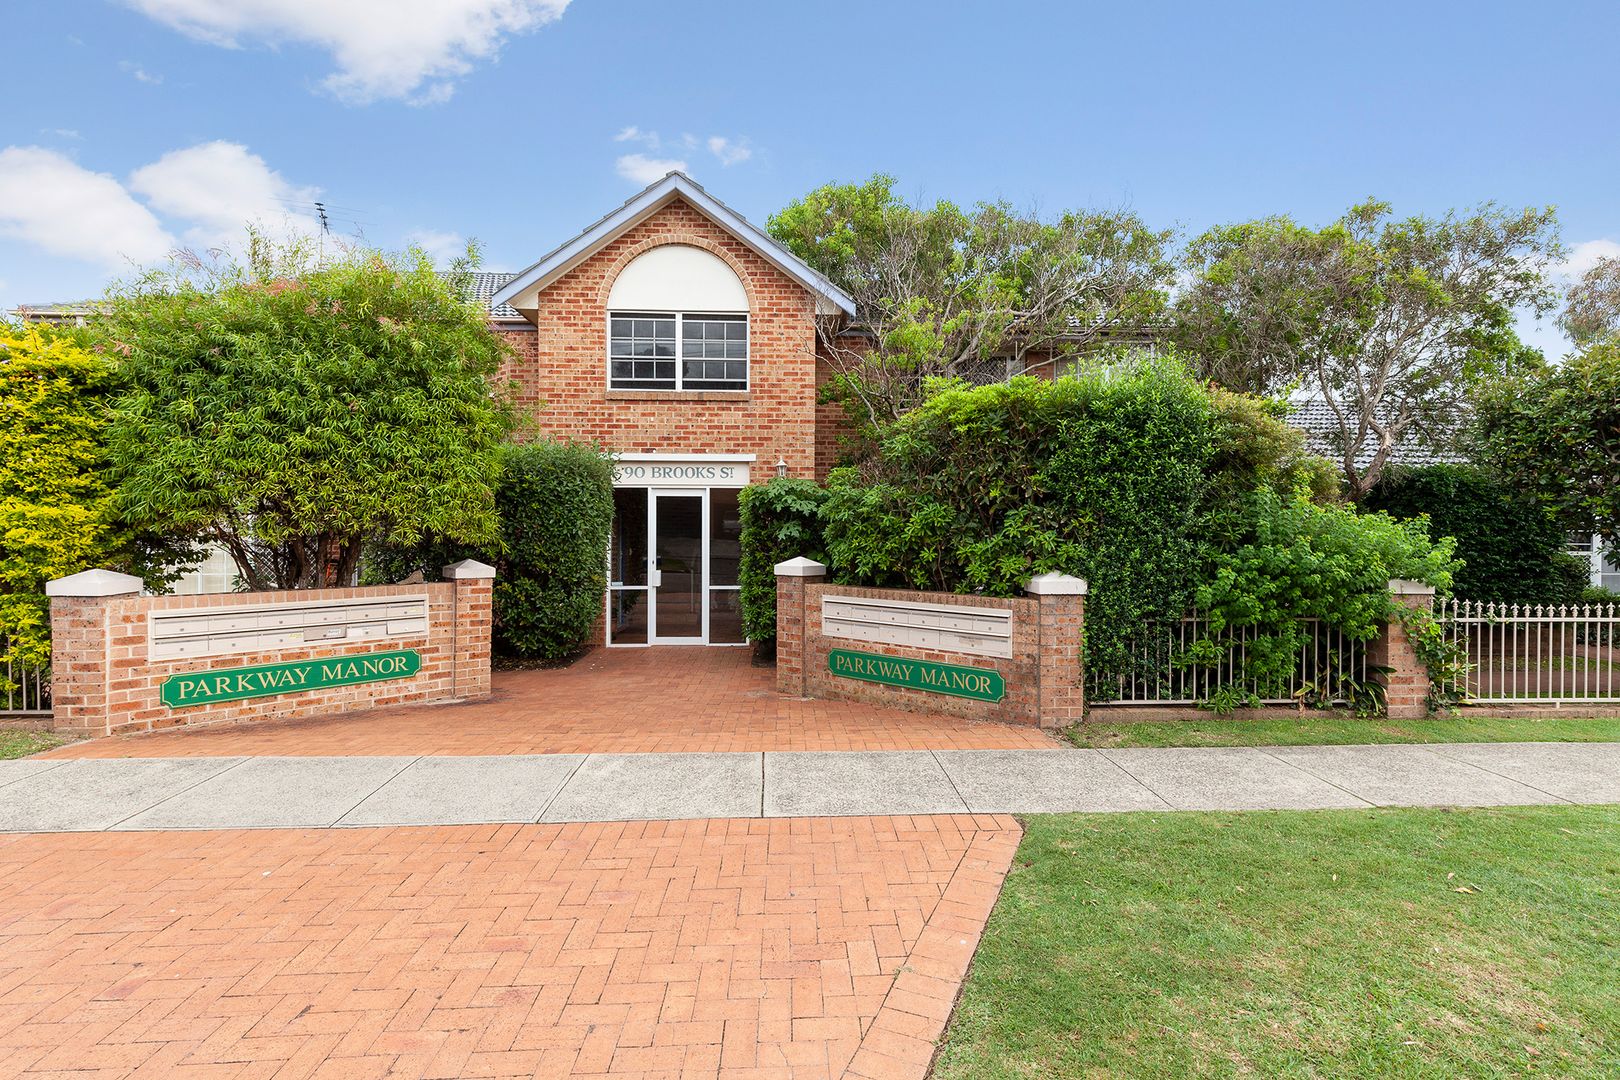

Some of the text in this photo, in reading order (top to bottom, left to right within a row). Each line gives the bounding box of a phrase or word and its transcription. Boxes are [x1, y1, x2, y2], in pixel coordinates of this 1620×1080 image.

[624, 466, 646, 479] 90
[651, 466, 716, 480] BROOKS
[177, 656, 409, 700] PARKWAY MANOR
[835, 655, 992, 695] PARKWAY MANOR
